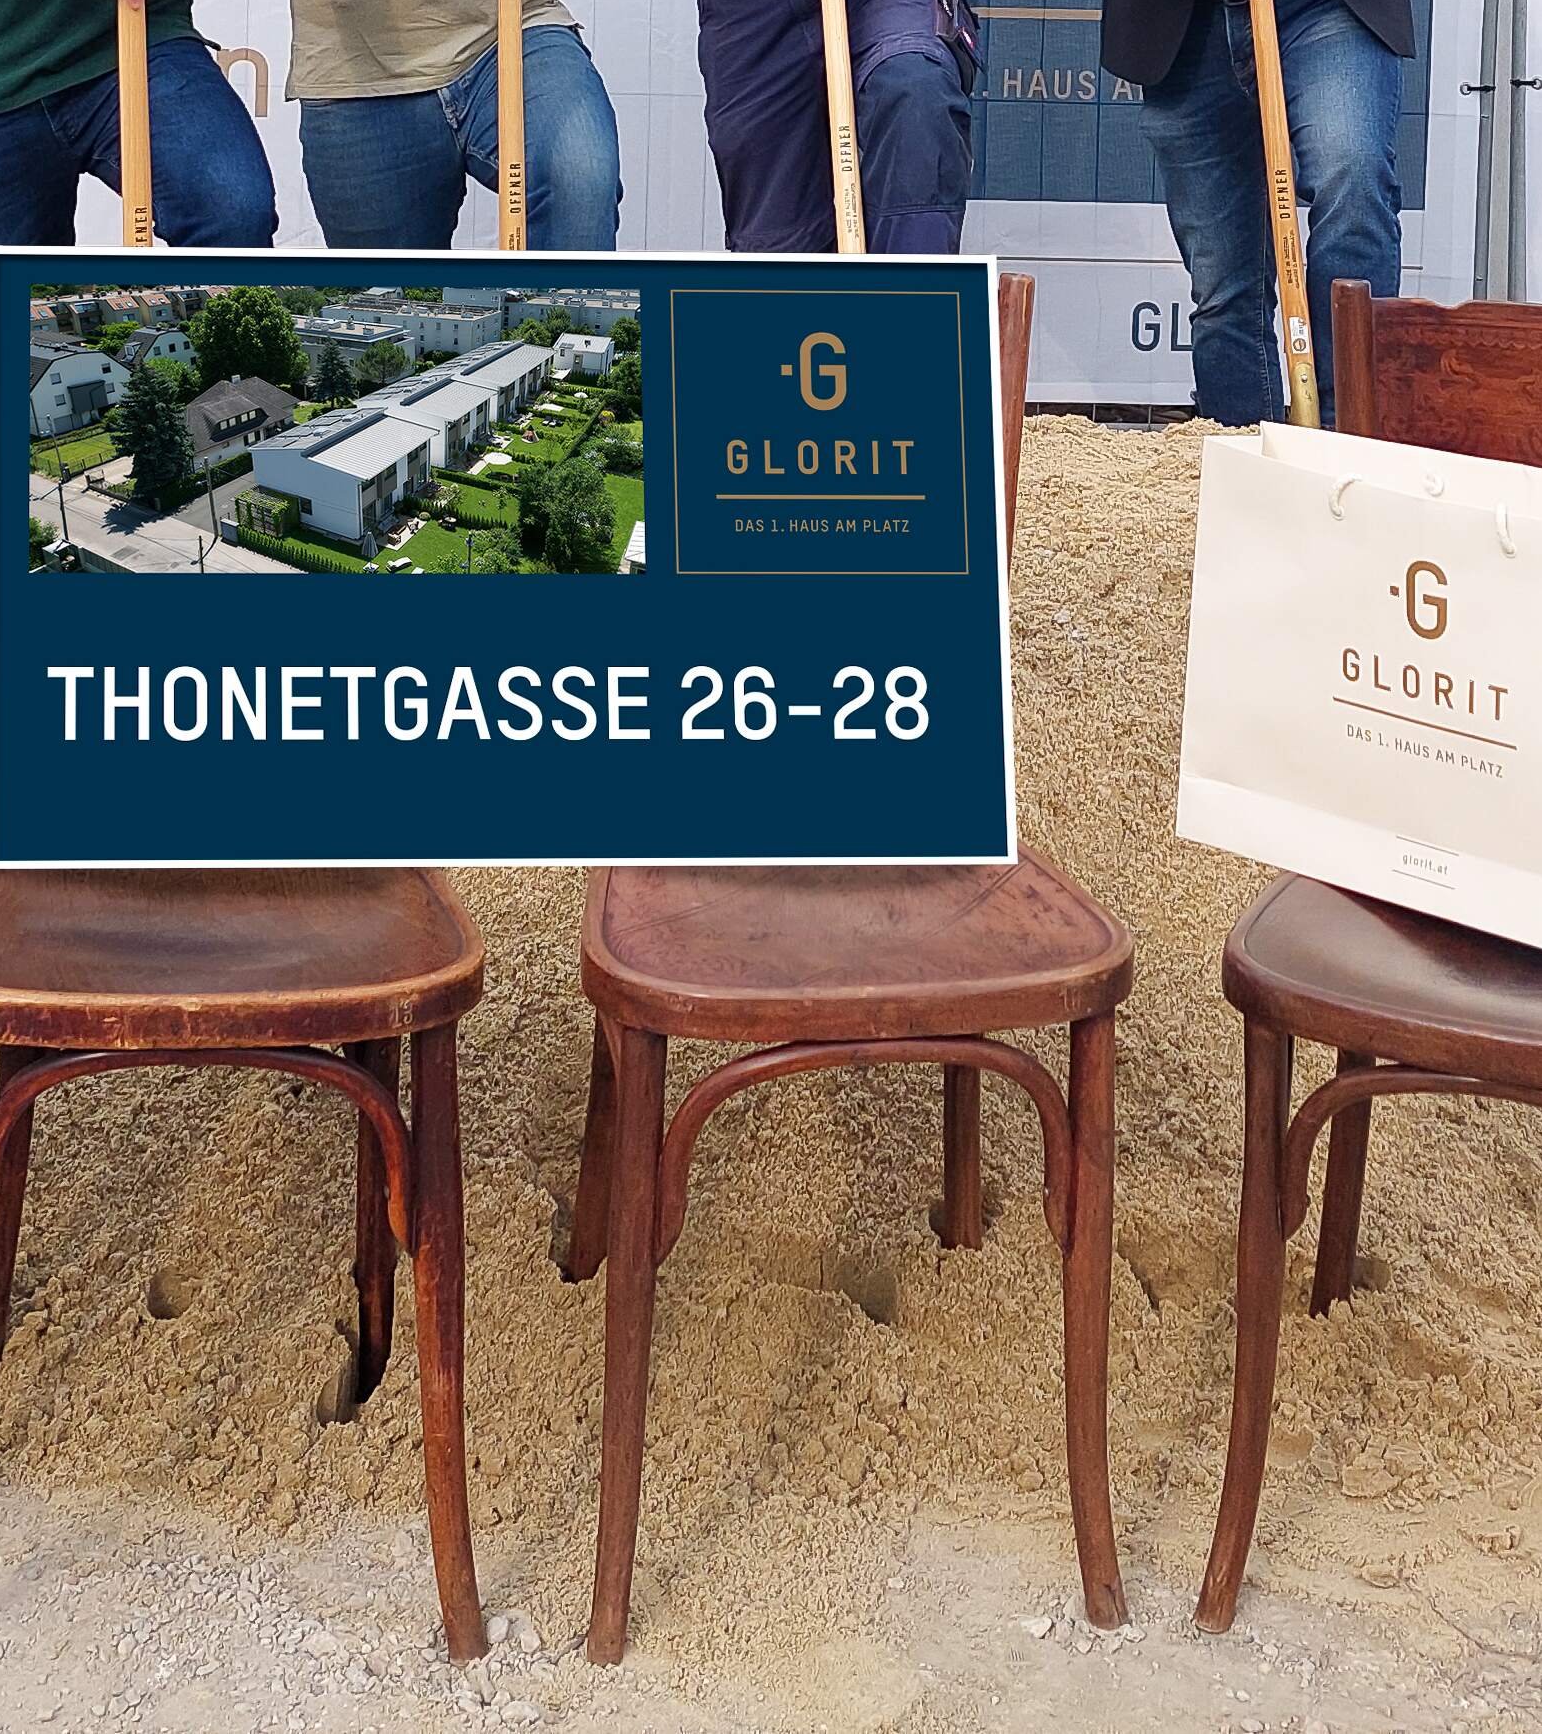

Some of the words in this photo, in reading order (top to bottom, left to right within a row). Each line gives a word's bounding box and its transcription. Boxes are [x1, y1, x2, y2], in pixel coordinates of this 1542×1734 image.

[1002, 68, 1097, 101] HAUS
[134, 207, 148, 247] FNER
[726, 439, 915, 475] GLORIT
[734, 519, 765, 533] DAS
[770, 519, 786, 533] 1.
[789, 519, 830, 533] HAUS
[835, 519, 858, 534] AM
[862, 519, 911, 534] PLATZ
[1341, 647, 1510, 721] GLORIT
[47, 665, 652, 742] THONETGASSE
[678, 665, 932, 742] 26-28
[1346, 723, 1373, 742] DAS
[1378, 732, 1390, 748] 1.
[1394, 737, 1431, 759] HAUS
[1435, 749, 1456, 766] AM
[1460, 754, 1504, 779] PLATZ
[1401, 853, 1449, 876] glorit.at
